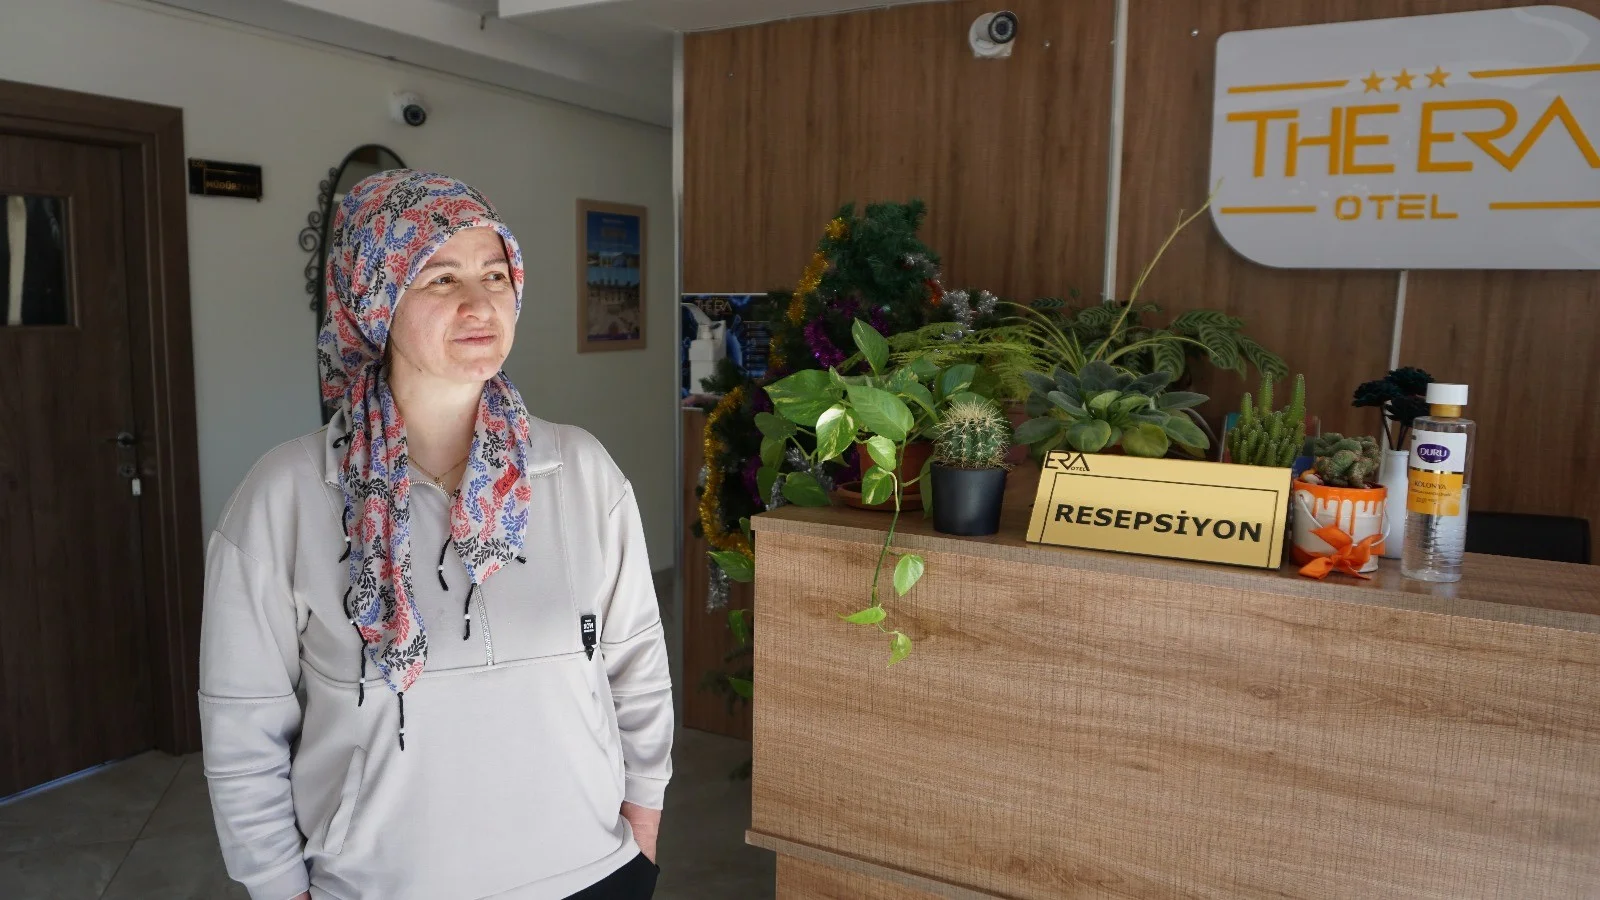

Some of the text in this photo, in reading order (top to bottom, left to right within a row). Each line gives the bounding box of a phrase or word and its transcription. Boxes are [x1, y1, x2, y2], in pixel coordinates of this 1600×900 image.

[1227, 95, 1600, 178] THE ERA
[1334, 194, 1458, 221] OTEL
[1044, 450, 1091, 471] ERA
[1420, 447, 1447, 457] DURU
[1414, 480, 1447, 490] KOLONYA
[1054, 503, 1263, 542] RESEPSİYON
